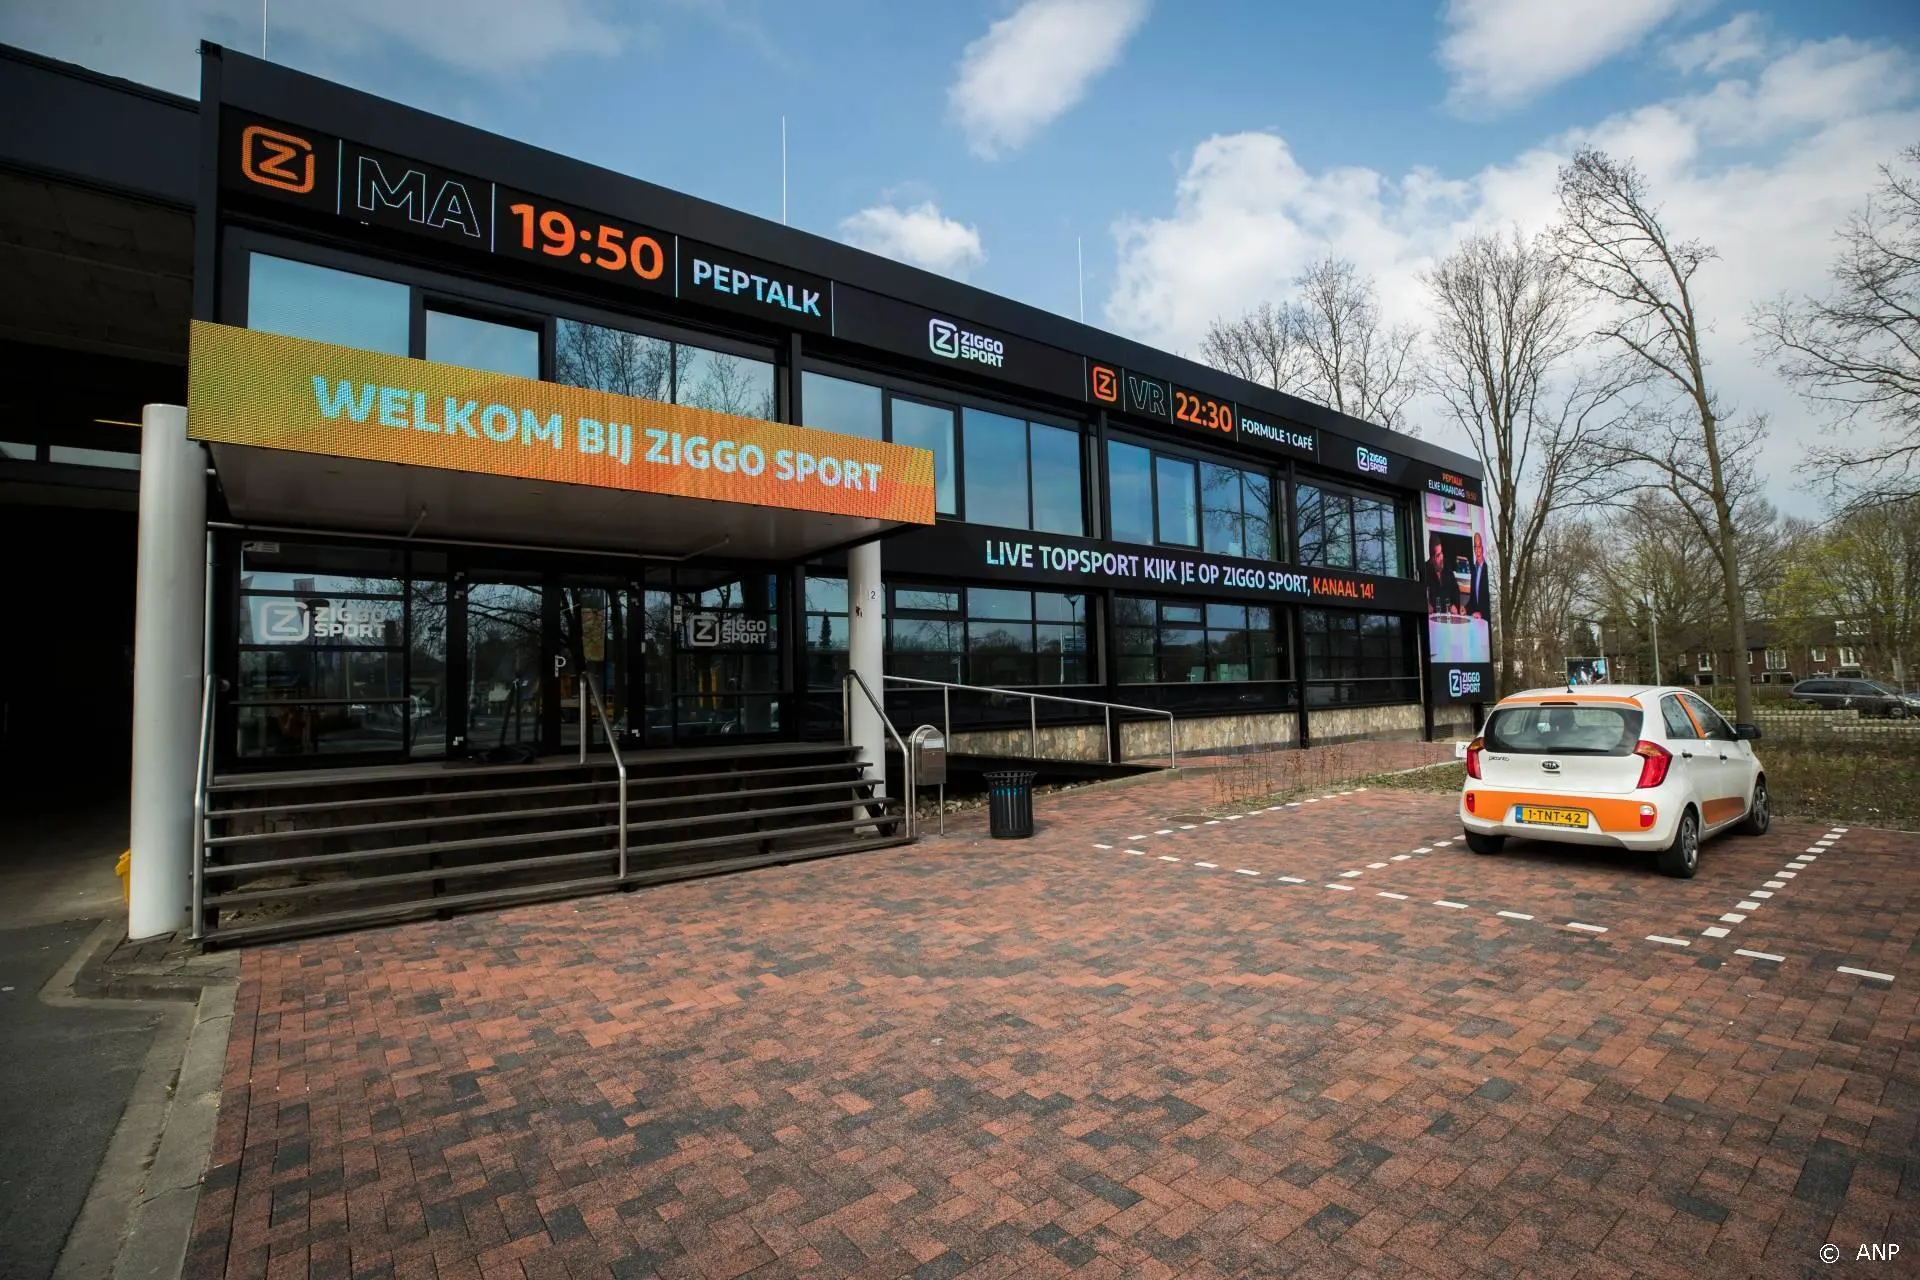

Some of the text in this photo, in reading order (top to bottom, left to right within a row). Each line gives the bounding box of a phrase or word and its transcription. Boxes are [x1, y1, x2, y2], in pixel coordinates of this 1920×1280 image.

[358, 156, 481, 238] MA
[510, 203, 664, 281] 19:50
[693, 258, 822, 318] PEPTALK
[960, 330, 1004, 354] ZIGGO
[961, 345, 1004, 367] SPORT
[1129, 376, 1166, 416] VR
[1175, 391, 1233, 433] 22:30
[311, 374, 882, 492] WELKOM BIJ ZIGGO SPORT
[1241, 418, 1313, 451] FORMULE 1 CAFÉ
[1369, 452, 1388, 465] ZIGGO
[1369, 462, 1388, 474] SPORT
[986, 540, 1375, 600] LIVE TOPSPORT KIJK JE OP ZIGGO SPORT, KANAAL 14!
[871, 590, 876, 599] 2
[314, 606, 386, 622] ZIGGO
[314, 623, 386, 638] SPORT
[722, 619, 767, 632] ZIGGO
[722, 632, 767, 644] SPORT
[1462, 671, 1481, 683] ZIGGO
[1462, 682, 1481, 694] SPORT
[1528, 809, 1582, 824] 1-TNT-42
